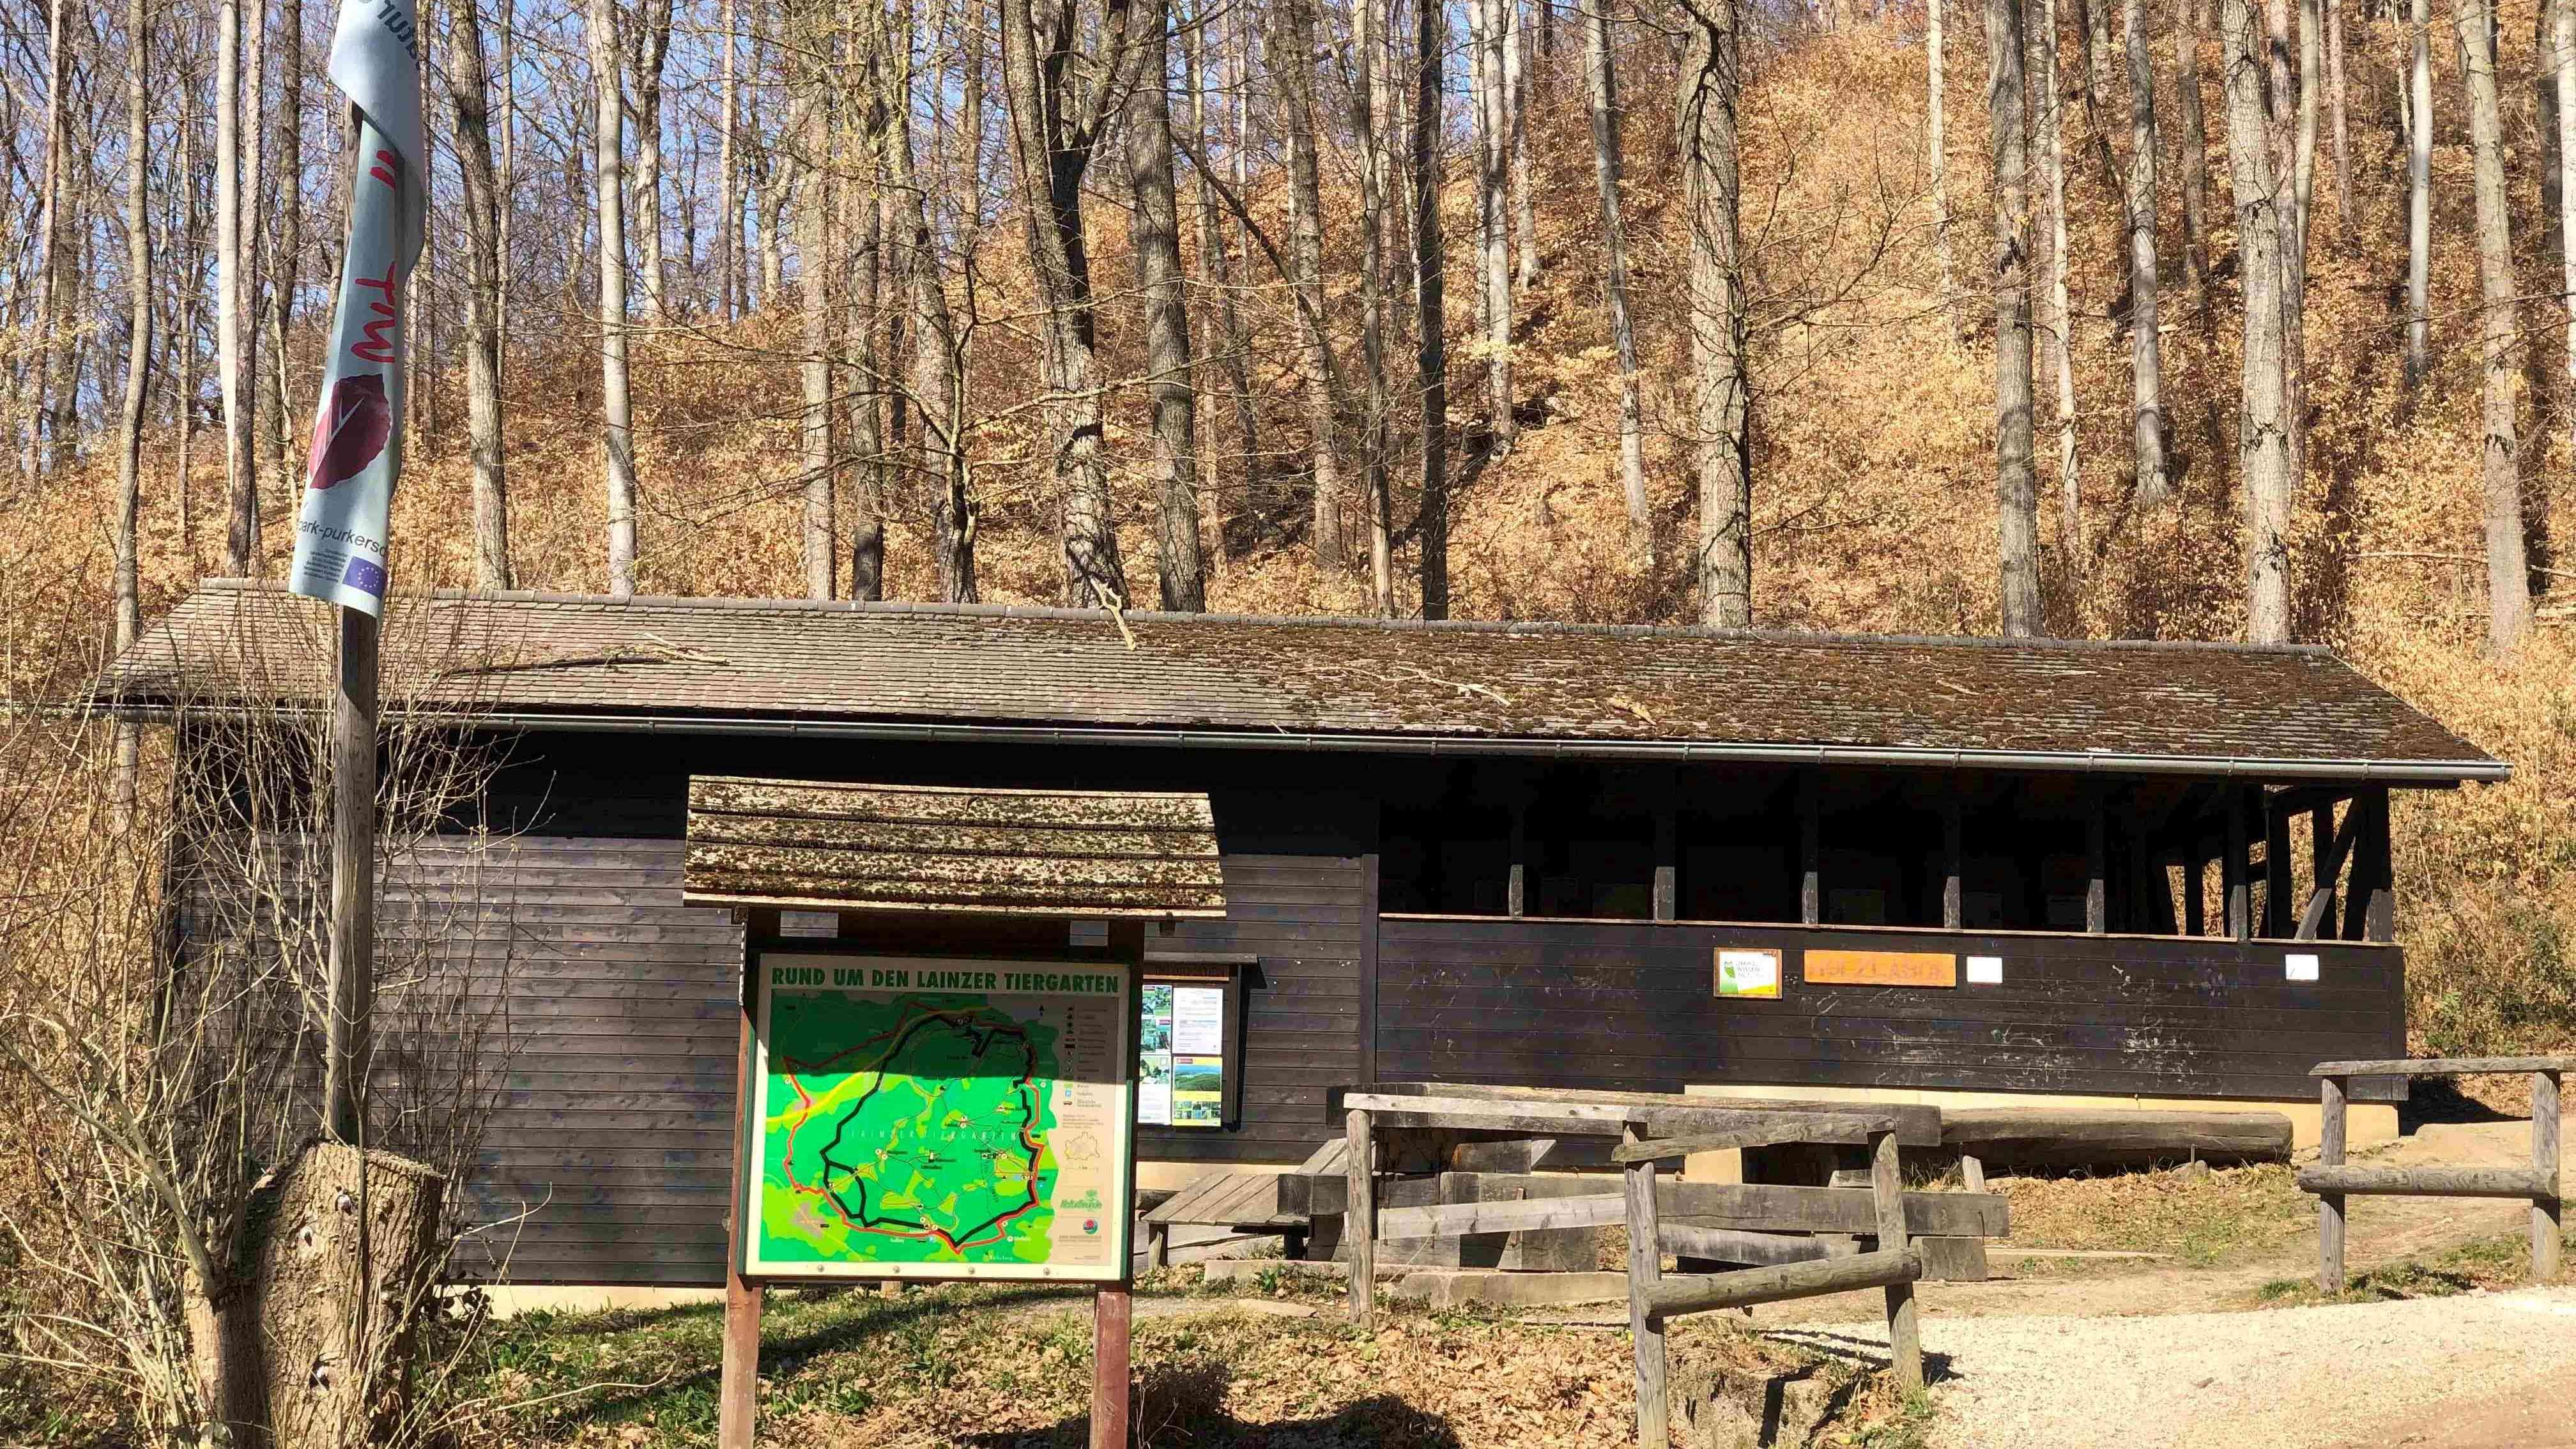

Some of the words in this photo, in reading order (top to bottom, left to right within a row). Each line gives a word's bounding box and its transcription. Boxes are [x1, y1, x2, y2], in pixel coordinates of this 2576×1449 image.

[772, 967, 825, 985] RUND
[833, 969, 864, 986] UM
[871, 969, 908, 987] DEN
[917, 970, 997, 990] LAINZER
[1004, 973, 1118, 993] TIERGARTEN
